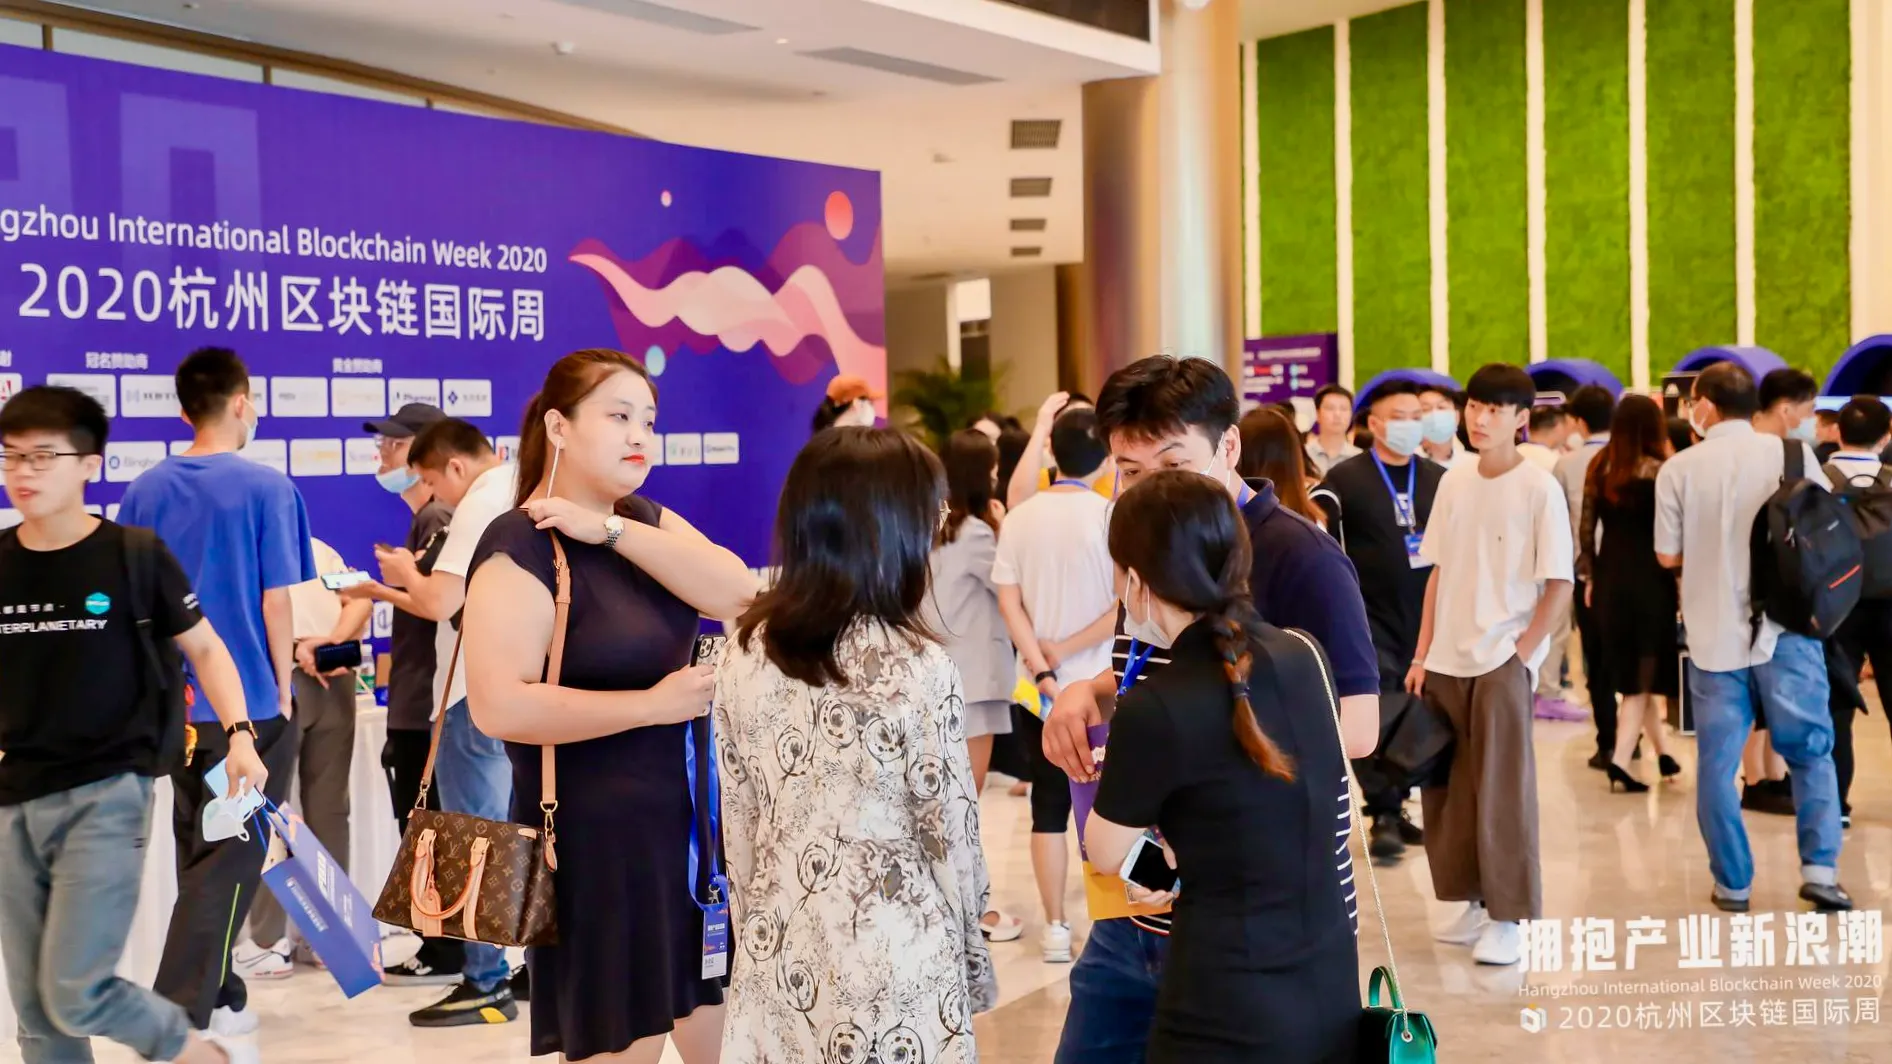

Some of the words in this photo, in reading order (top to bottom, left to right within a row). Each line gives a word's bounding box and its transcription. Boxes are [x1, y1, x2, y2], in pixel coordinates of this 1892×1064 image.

[0, 204, 99, 242] gzhou
[109, 212, 290, 255] International
[297, 228, 426, 264] Blockchain
[432, 240, 492, 270] Week
[497, 244, 548, 274] 2020
[18, 262, 546, 343] 2020杭州区块链国际周
